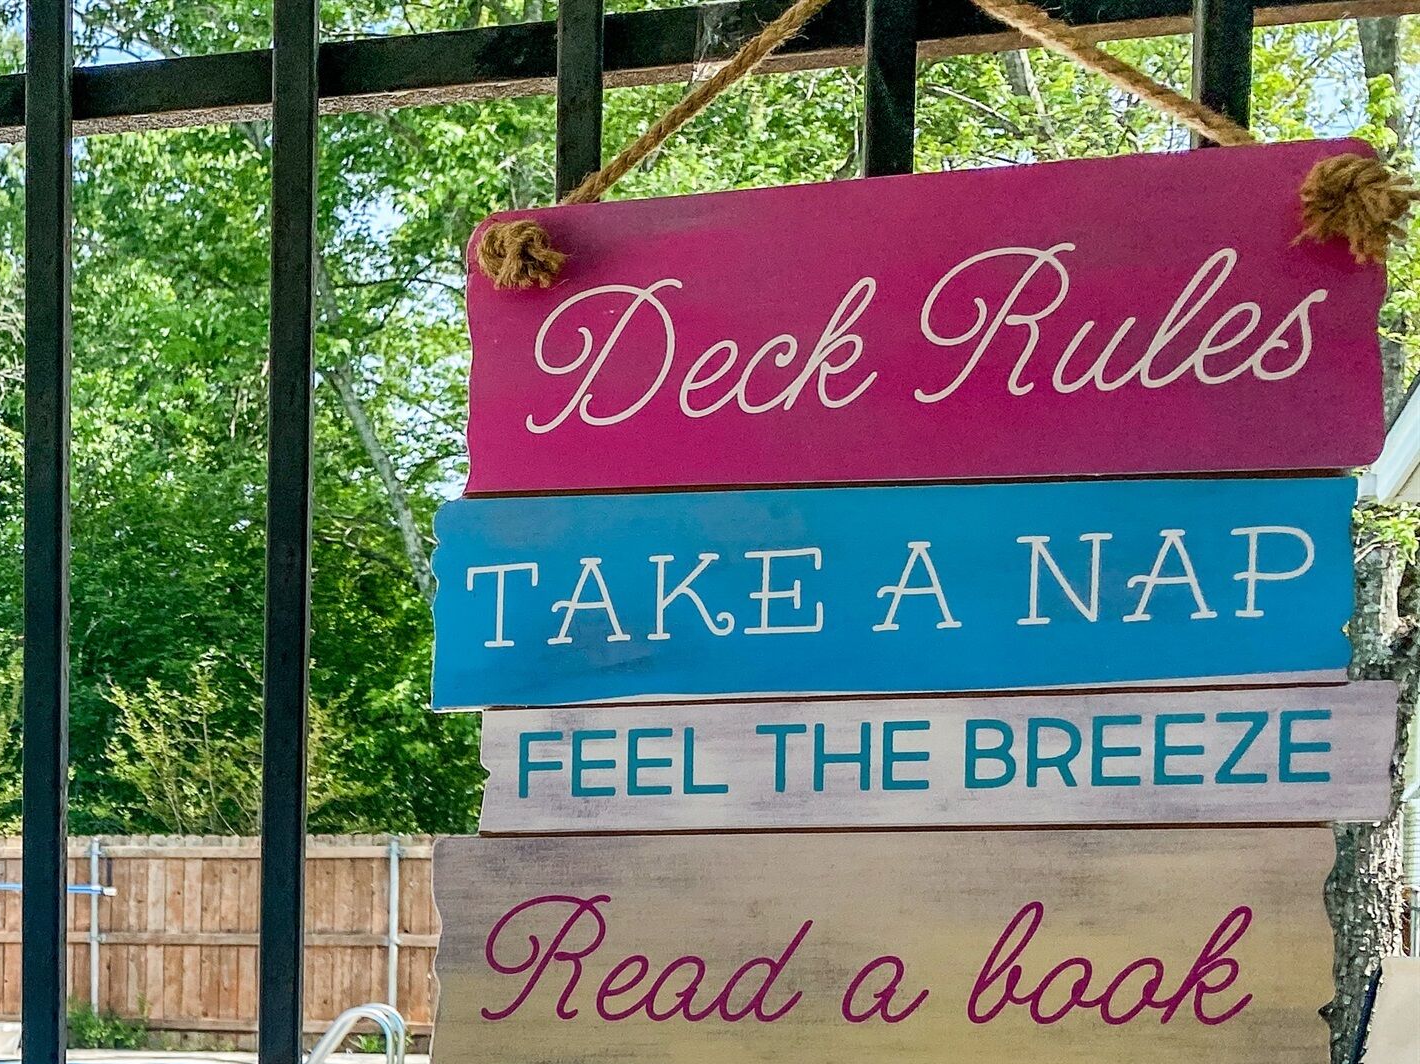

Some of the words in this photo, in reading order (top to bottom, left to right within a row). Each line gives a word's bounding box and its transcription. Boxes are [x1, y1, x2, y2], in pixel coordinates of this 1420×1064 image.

[525, 277, 877, 434] Deck
[914, 242, 1329, 405] Rules
[466, 546, 824, 647] TAKE
[872, 540, 962, 632] A
[1016, 525, 1316, 626] NAP
[518, 726, 729, 798] FEEL
[755, 721, 931, 793] THE
[964, 709, 1332, 790] BREEZE
[481, 894, 814, 1023] Read
[840, 954, 928, 1024] a
[967, 901, 1253, 1026] book
